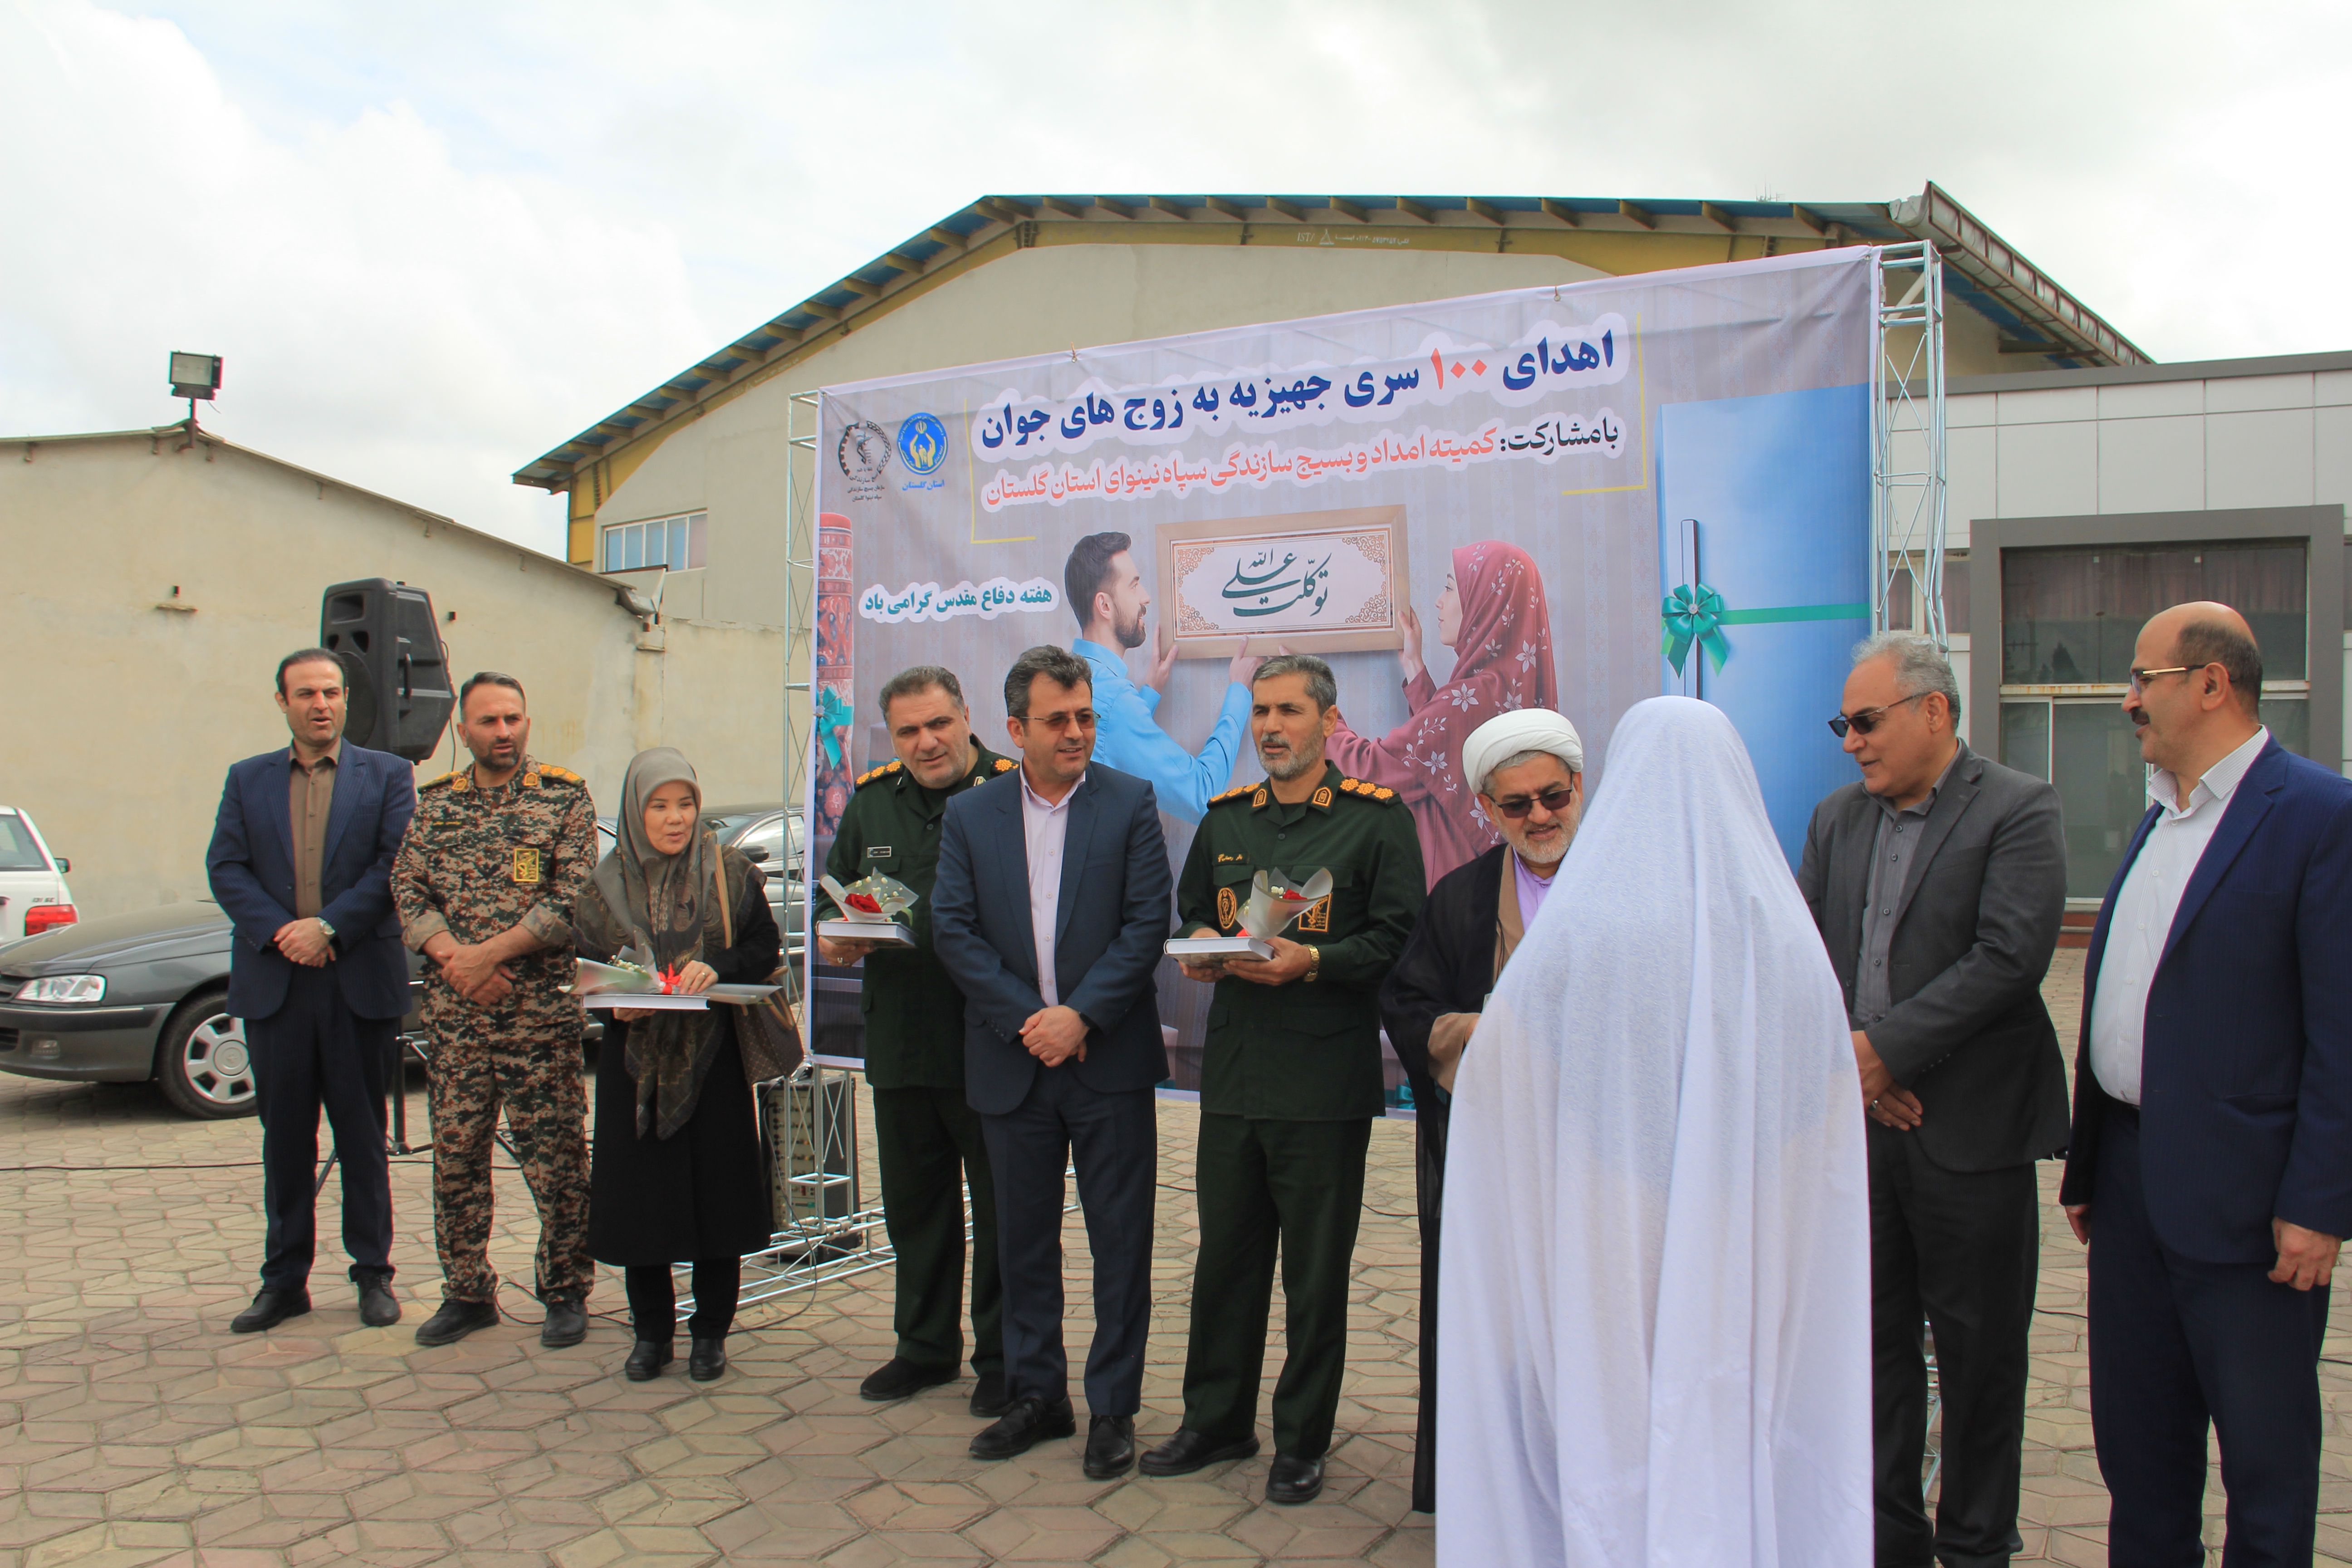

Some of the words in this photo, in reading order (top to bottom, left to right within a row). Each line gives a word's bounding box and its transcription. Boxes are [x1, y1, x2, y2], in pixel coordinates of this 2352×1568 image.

[1431, 348, 1488, 390] ۱۰۰
[1503, 328, 1614, 390] اهدای
[1192, 386, 1219, 420] به
[1229, 375, 1332, 417] جهیزیه
[1344, 368, 1420, 407] سری
[982, 402, 1050, 447] جوان
[1060, 392, 1115, 438] های
[1123, 388, 1183, 430] زوج
[1371, 433, 1426, 465] امداد
[1429, 427, 1498, 464] کمیته
[1104, 464, 1161, 495] نینوای
[1163, 459, 1207, 492] سپاه
[1210, 449, 1293, 487] سازندگی
[1296, 451, 1354, 480] بسیج
[902, 481, 926, 492] گلستان
[927, 479, 945, 491] استان
[986, 470, 1049, 506] گلستان
[1051, 466, 1101, 500] استان
[864, 593, 883, 614] باد
[887, 590, 932, 615] گرامی
[936, 589, 977, 613] مقدس
[980, 585, 1015, 612] دفاع
[1019, 586, 1052, 603] هفته
